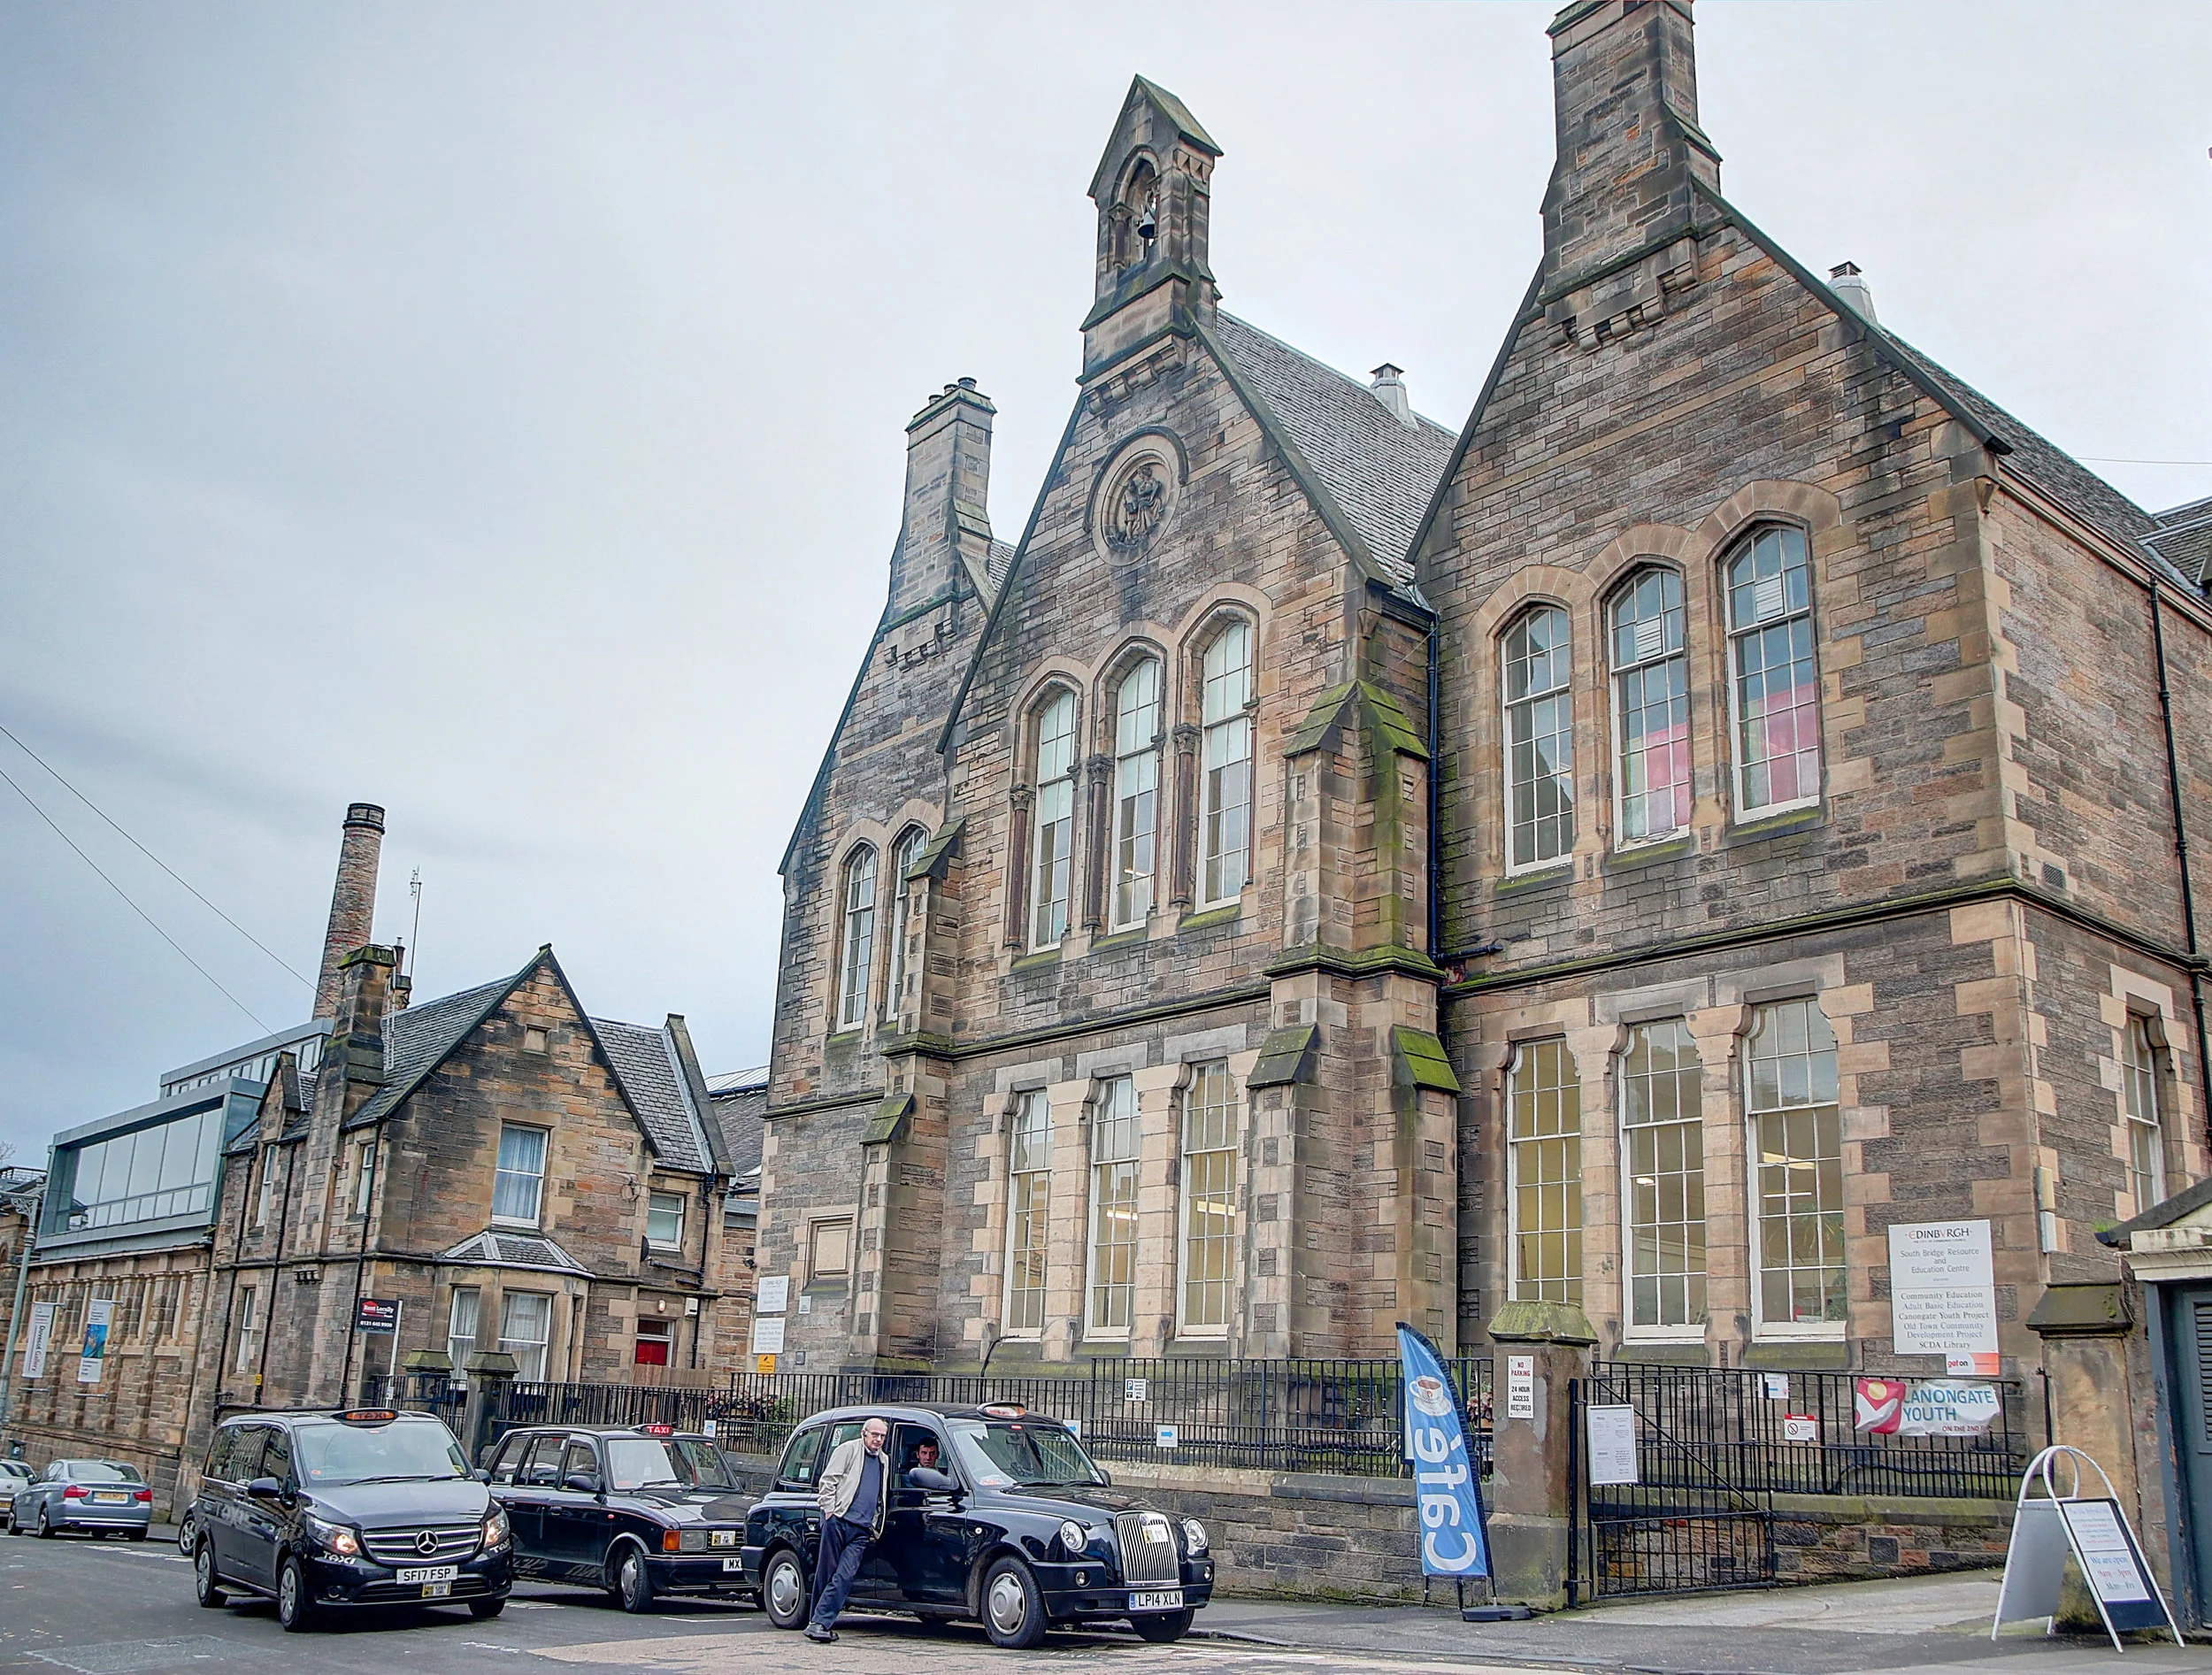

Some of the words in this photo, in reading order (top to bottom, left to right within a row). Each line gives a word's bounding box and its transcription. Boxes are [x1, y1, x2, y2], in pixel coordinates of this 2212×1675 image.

[1923, 1249, 1944, 1257] Bridge
[36, 1325, 46, 1350] Dovecot
[1902, 1407, 1956, 1422] YOUTH
[322, 1550, 357, 1565] TAXI
[403, 1570, 426, 1582] SF17
[430, 1568, 451, 1579] FSP
[1138, 1594, 1161, 1607] LP14
[1163, 1592, 1180, 1606] XLN
